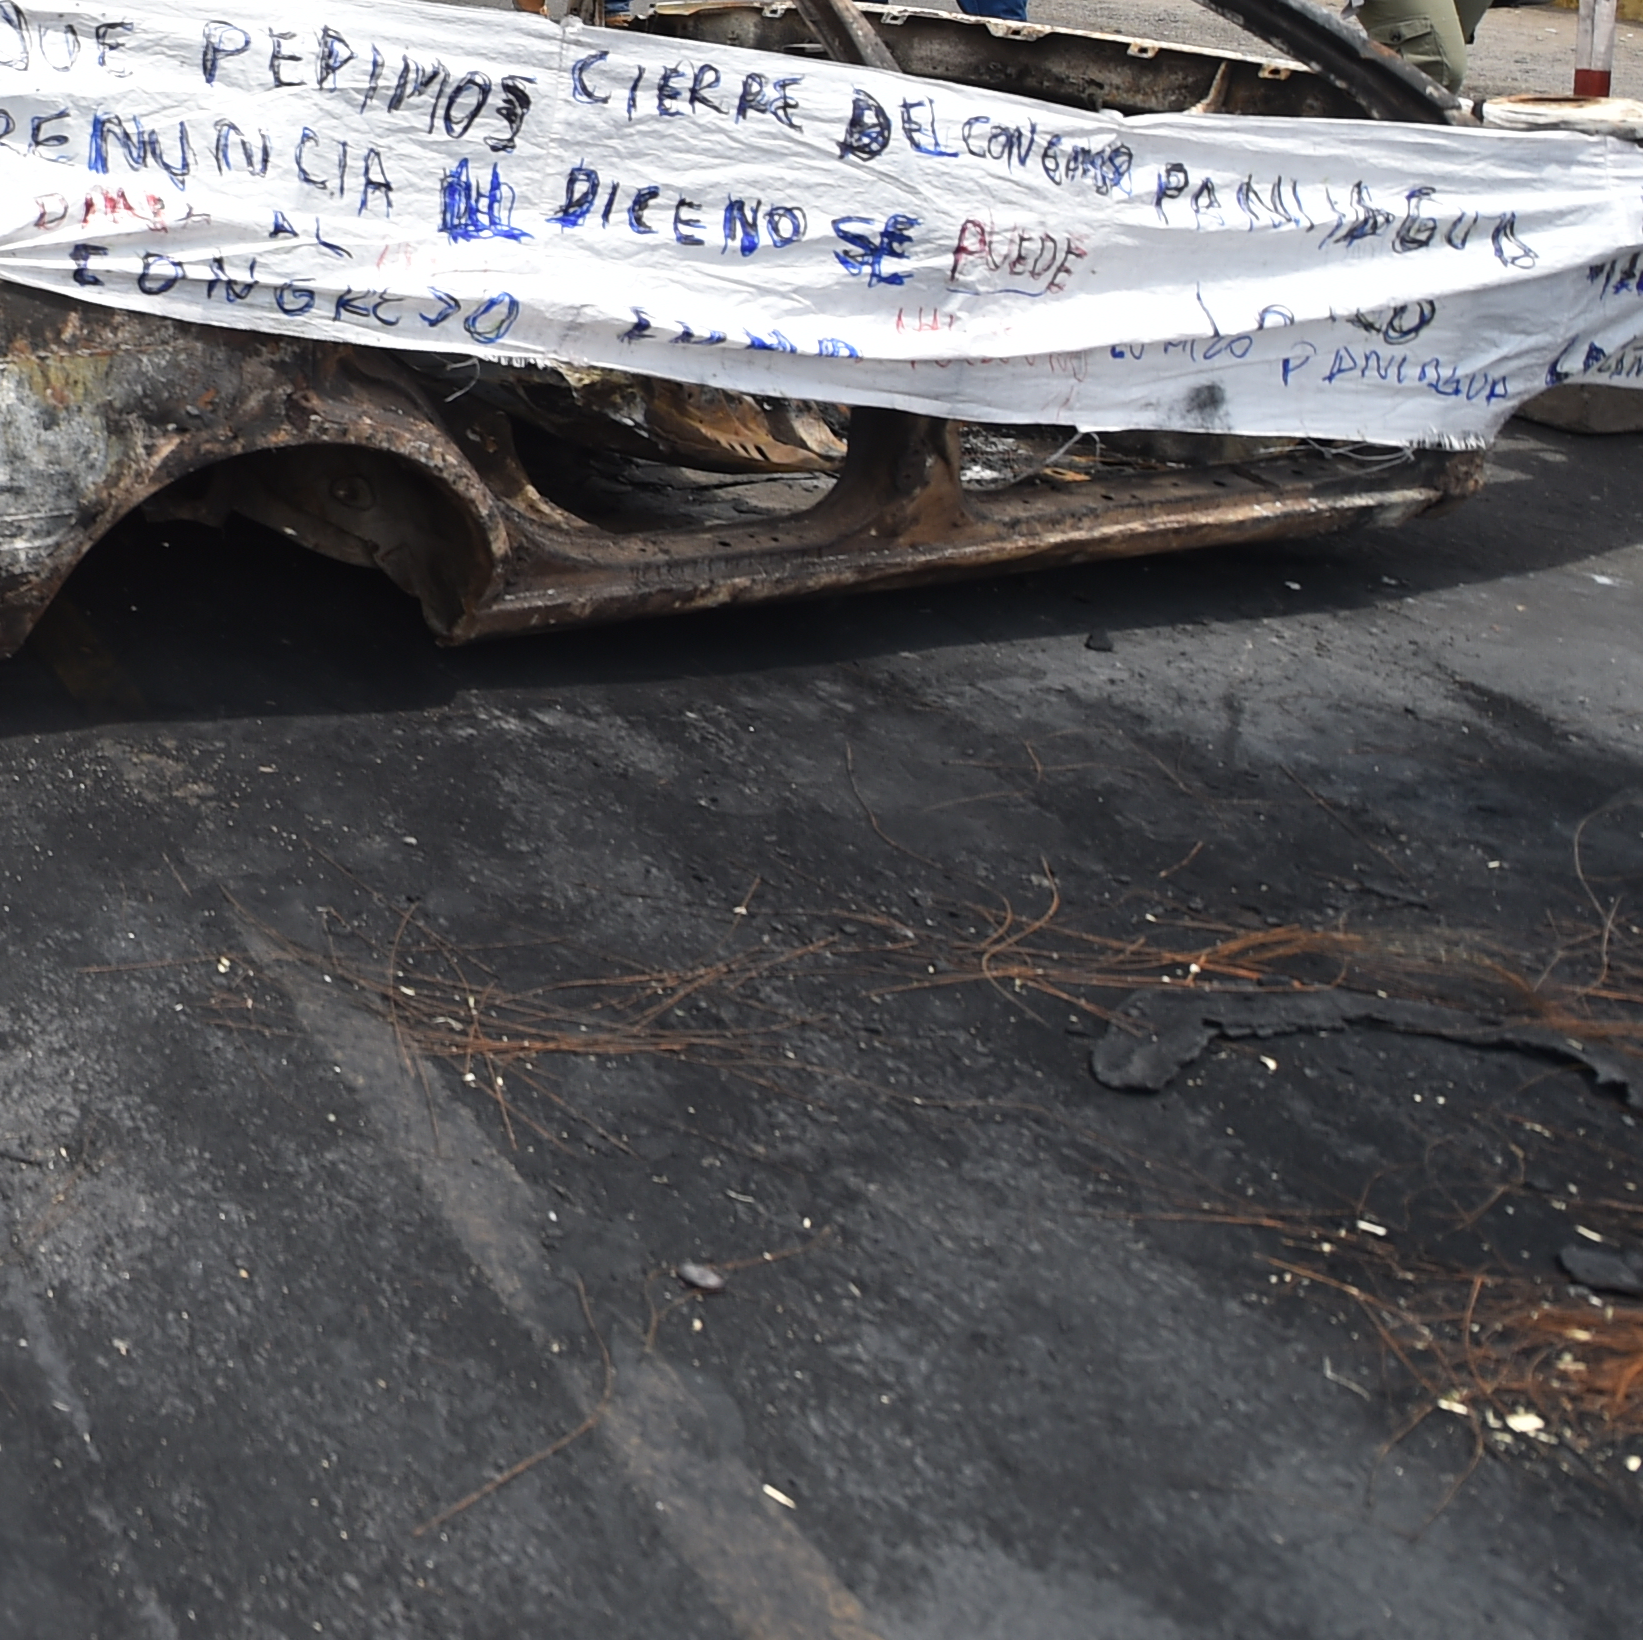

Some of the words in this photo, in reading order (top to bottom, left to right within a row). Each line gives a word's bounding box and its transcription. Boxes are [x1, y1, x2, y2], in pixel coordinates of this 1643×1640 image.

[202, 18, 539, 154] PEDIMOS
[572, 49, 806, 134] CIERRE
[948, 216, 1088, 294] PUEDE
